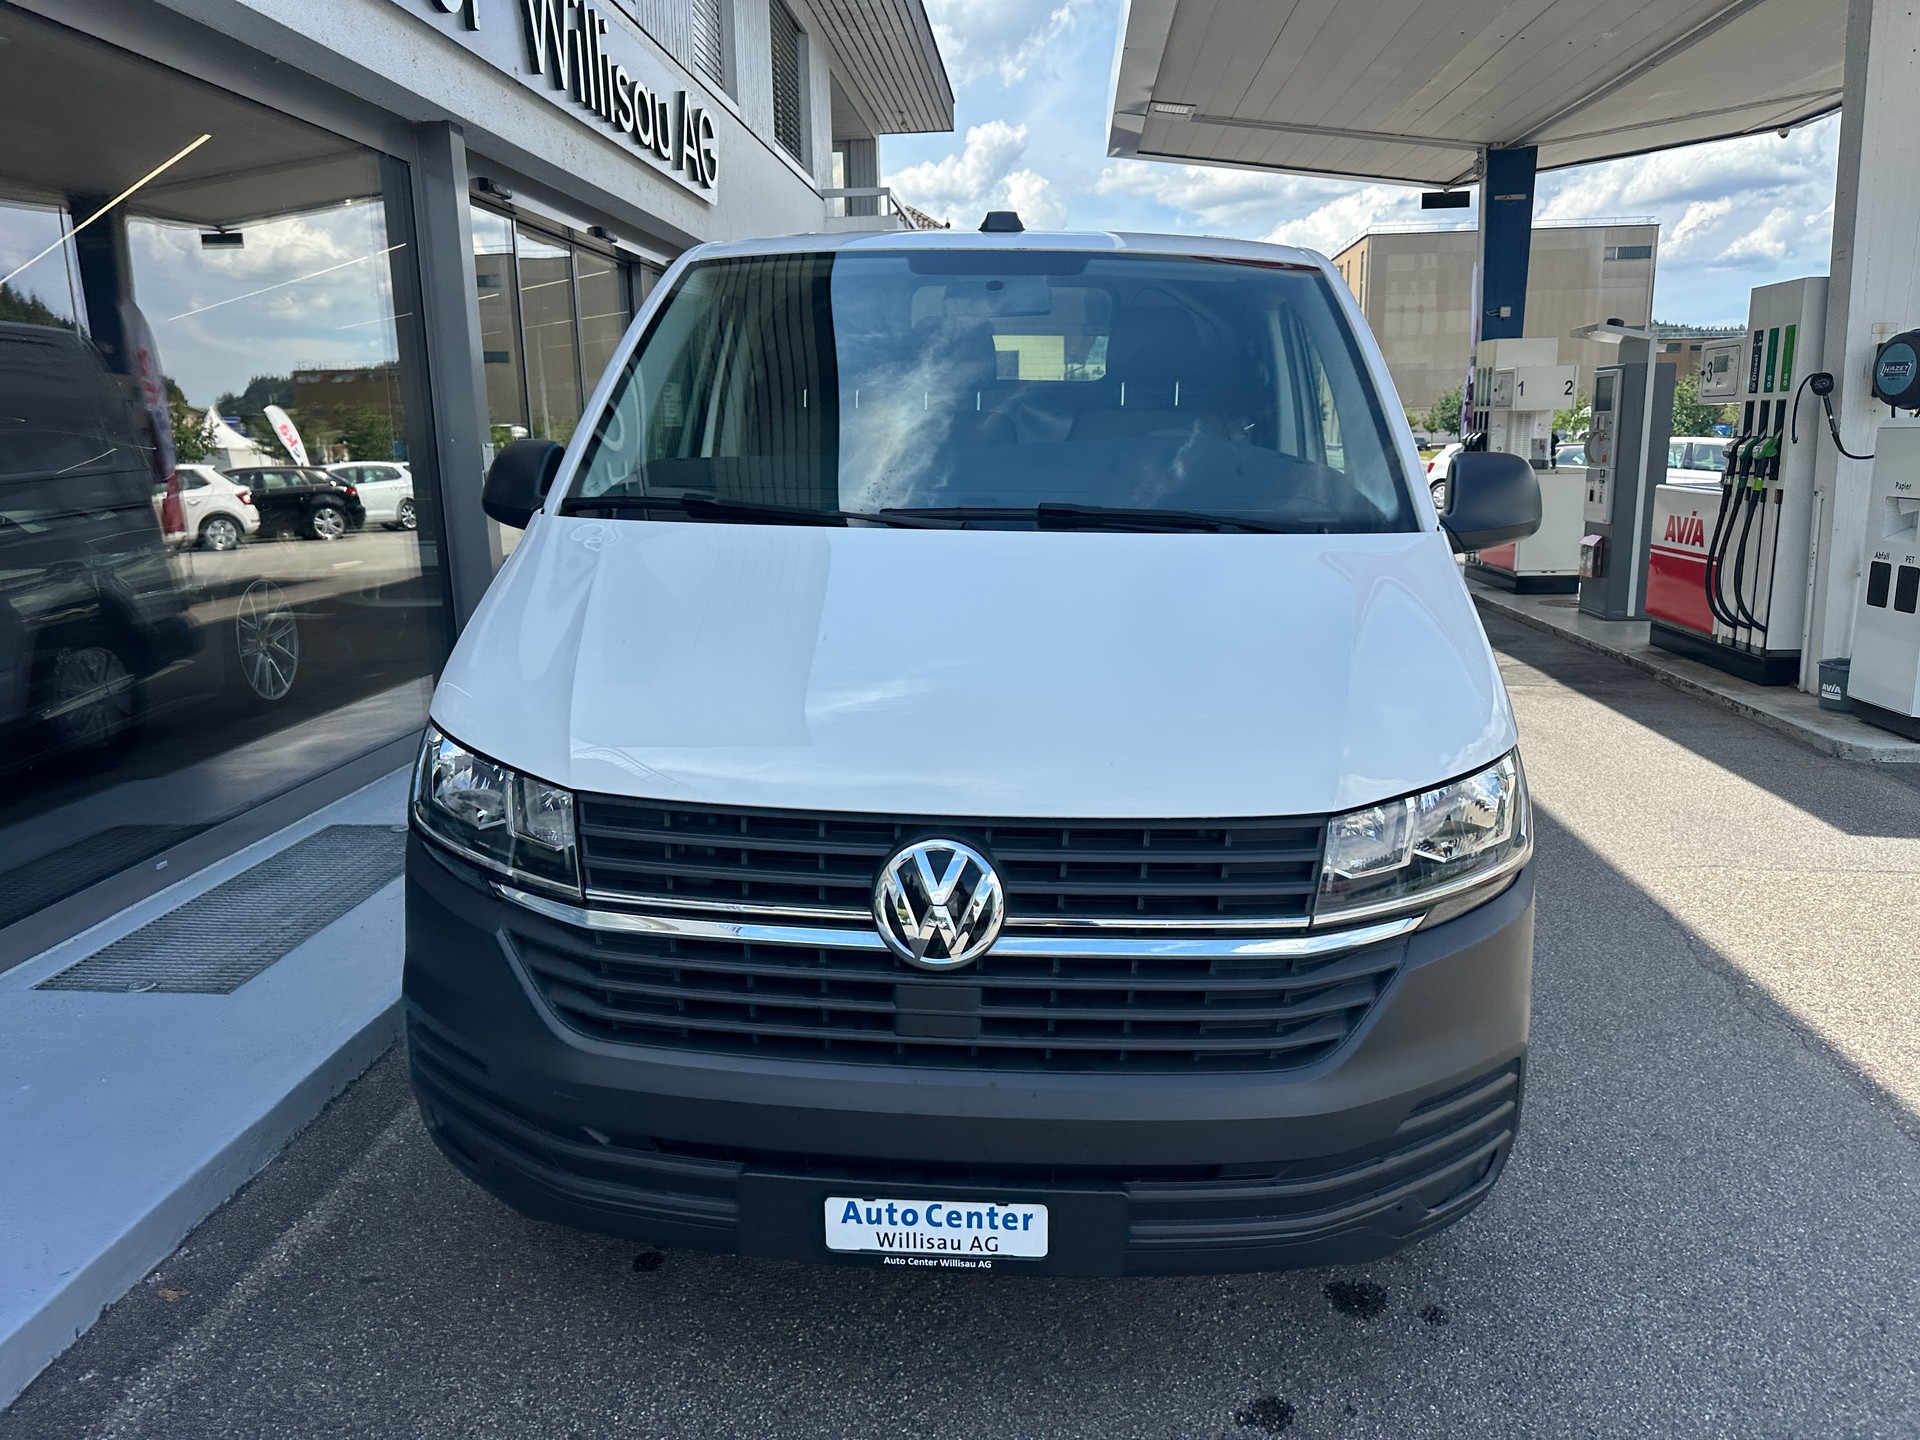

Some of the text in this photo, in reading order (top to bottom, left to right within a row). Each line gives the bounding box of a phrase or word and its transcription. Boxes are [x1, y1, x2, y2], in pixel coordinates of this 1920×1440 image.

[521, 0, 718, 190] Willisau AG
[1706, 361, 1713, 383] 3
[1884, 365, 1910, 373] HAZET
[1517, 381, 1524, 396] 1
[1564, 380, 1574, 395] 2
[1895, 481, 1912, 492] Papier
[1664, 510, 1704, 548] AVIA
[1874, 551, 1890, 561] Abfall
[1905, 555, 1916, 564] PET
[1821, 683, 1841, 694] AVIA
[841, 1200, 1034, 1231] Auto Center
[876, 1231, 999, 1252] Willisau AG
[884, 1256, 992, 1269] Auto Center Willisau AG
